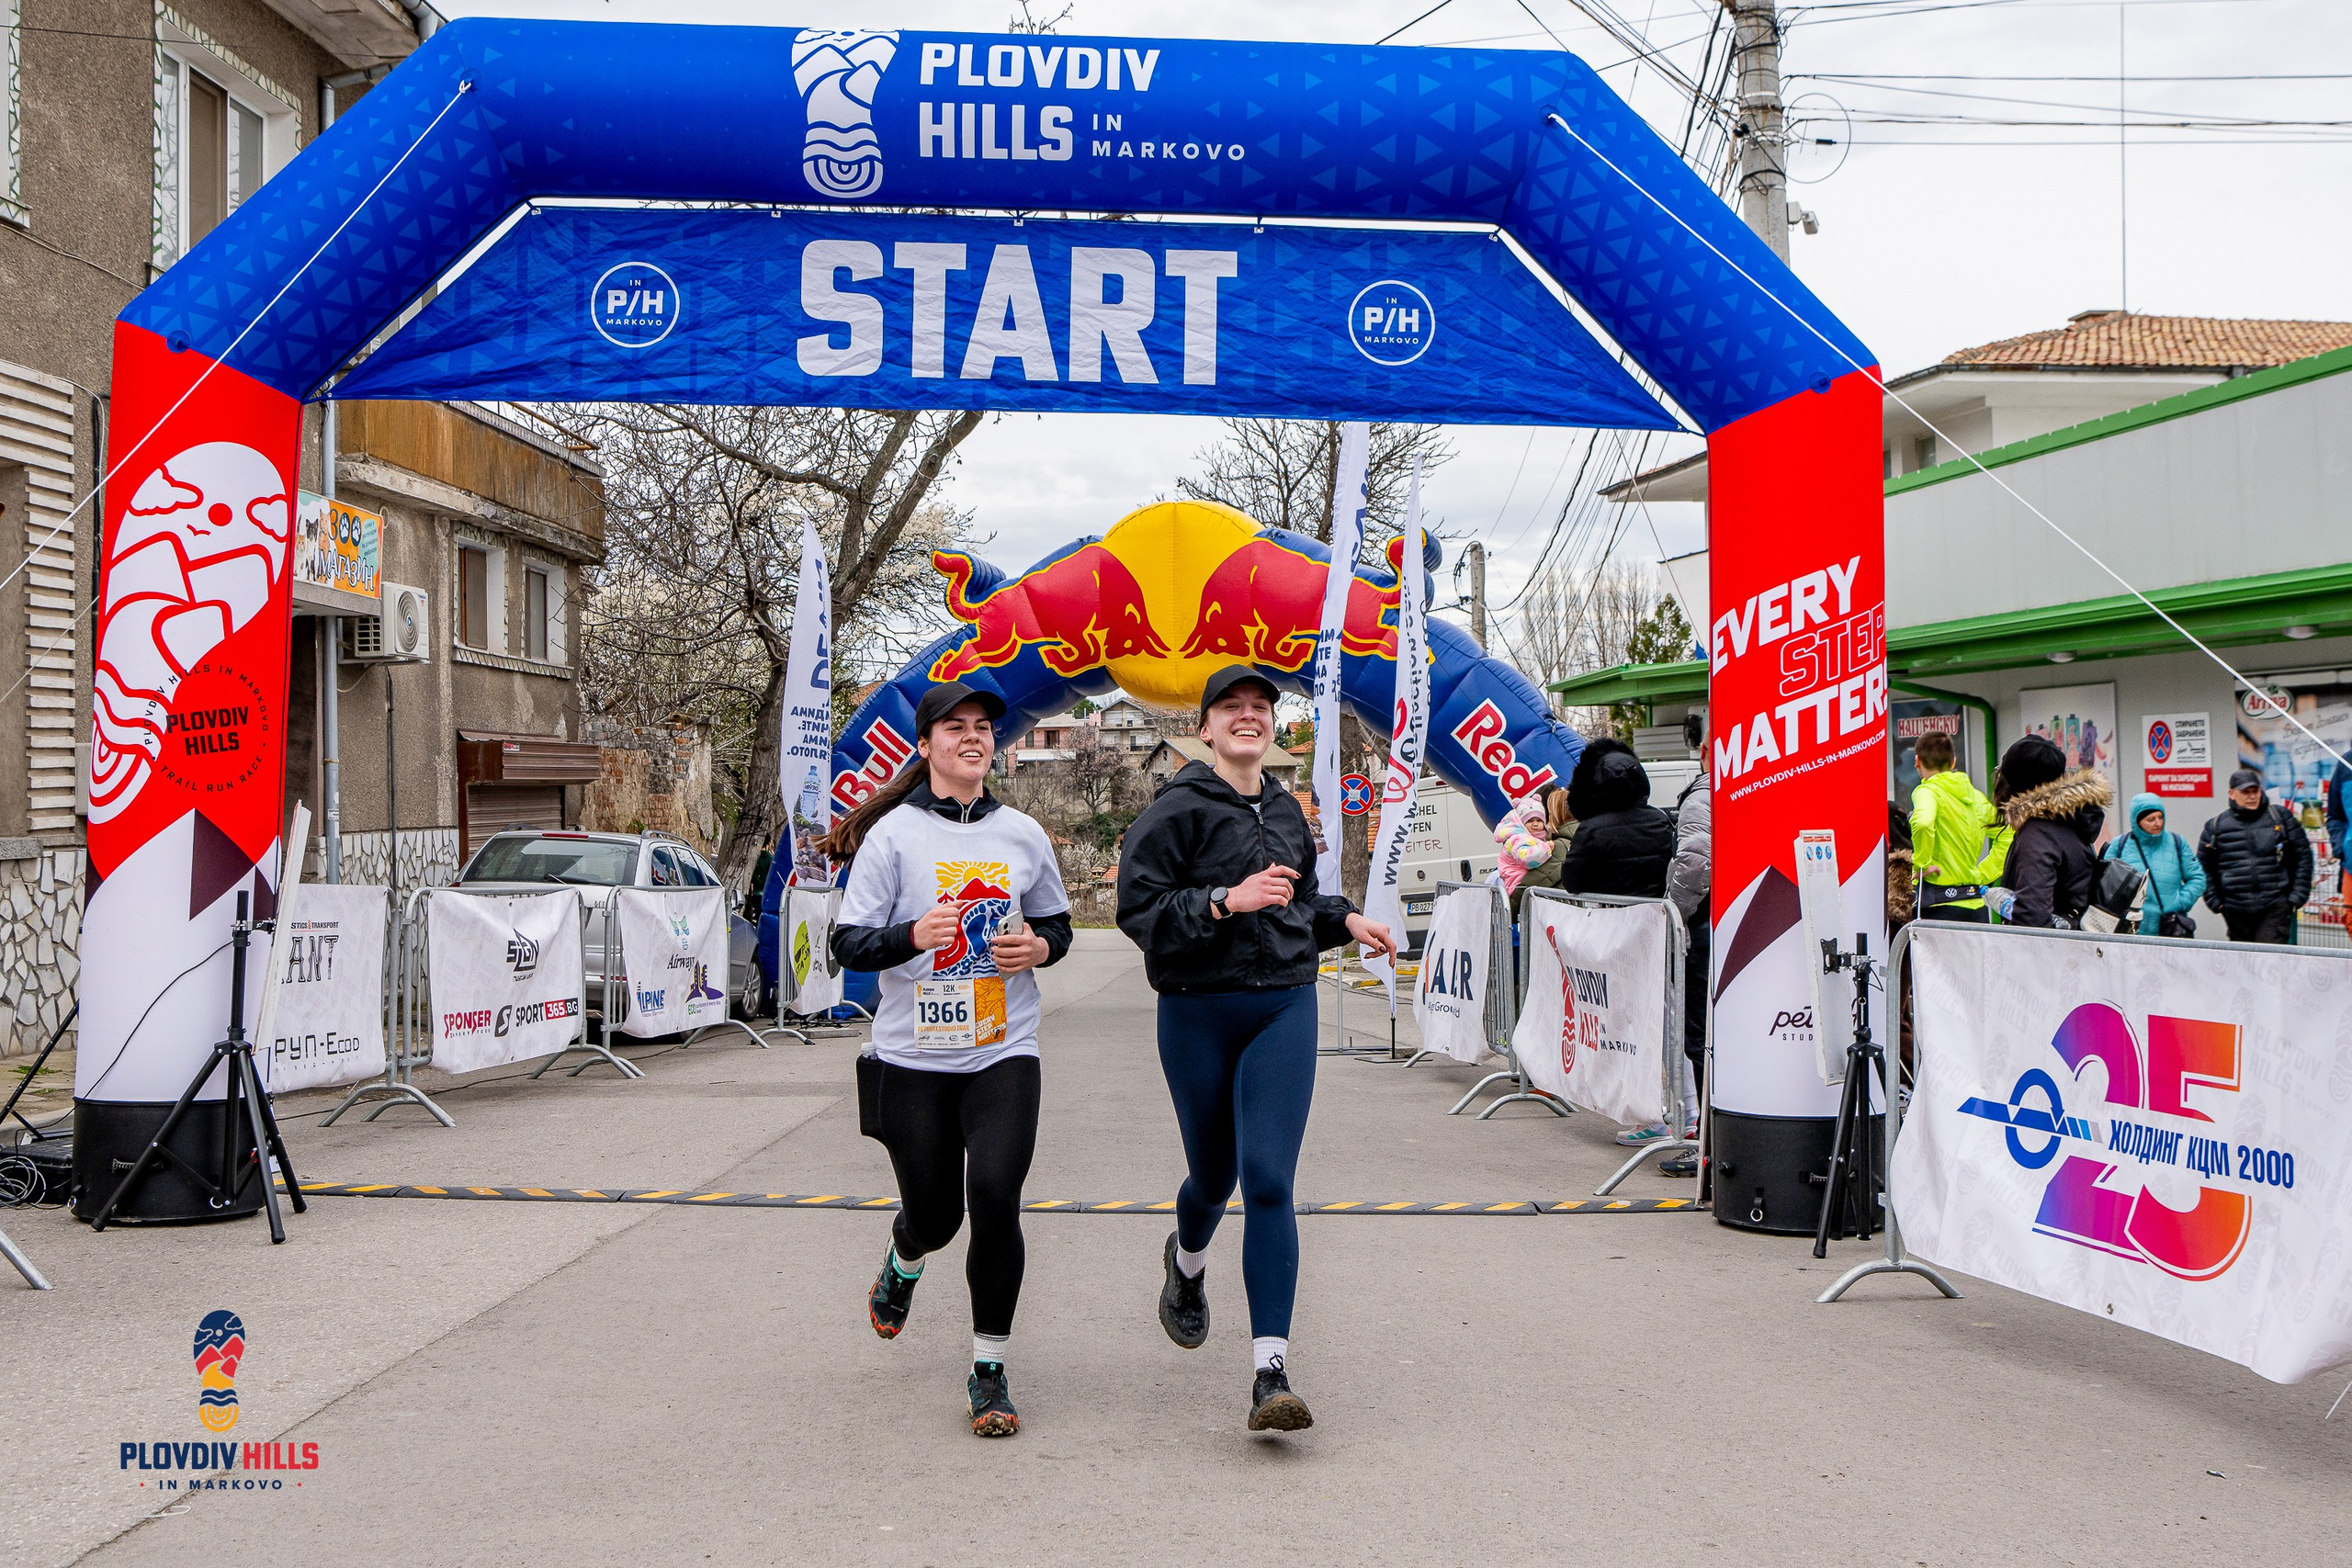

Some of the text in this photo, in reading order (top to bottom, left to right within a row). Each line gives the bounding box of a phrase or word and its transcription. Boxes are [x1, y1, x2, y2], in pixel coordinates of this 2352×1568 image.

[920, 42, 1161, 91] PLOVDIV
[920, 102, 1073, 161] HILLS
[1093, 114, 1122, 130] IN
[1092, 141, 1245, 161] MARKOVO
[607, 289, 664, 316] P/H
[797, 239, 1238, 386] START
[1364, 307, 1419, 334] P/H
[1364, 336, 1419, 344] MARKOVO
[318, 548, 374, 591] МАГАЗИН
[1713, 556, 1860, 677] EVERY
[1780, 601, 1884, 696] STEP
[144, 664, 268, 745] PLOVDIV HILLS IN MARKOVO
[166, 706, 248, 733] PLOVDIV
[185, 732, 240, 756] HILLS
[1897, 715, 1960, 738] НАШЕНСКО
[831, 721, 912, 810] Bull
[1455, 703, 1554, 800] Red
[160, 756, 263, 792] TRAIL RUN RACE
[943, 984, 956, 992] 12K
[444, 1010, 492, 1039] SPONSER
[515, 1004, 544, 1027] SPORT
[919, 1001, 967, 1023] 1366
[2032, 998, 2252, 1281] 25
[2109, 1119, 2184, 1166] ХОЛДИНГ
[2187, 1136, 2231, 1179] КЦМ
[2238, 1145, 2294, 1190] 2000
